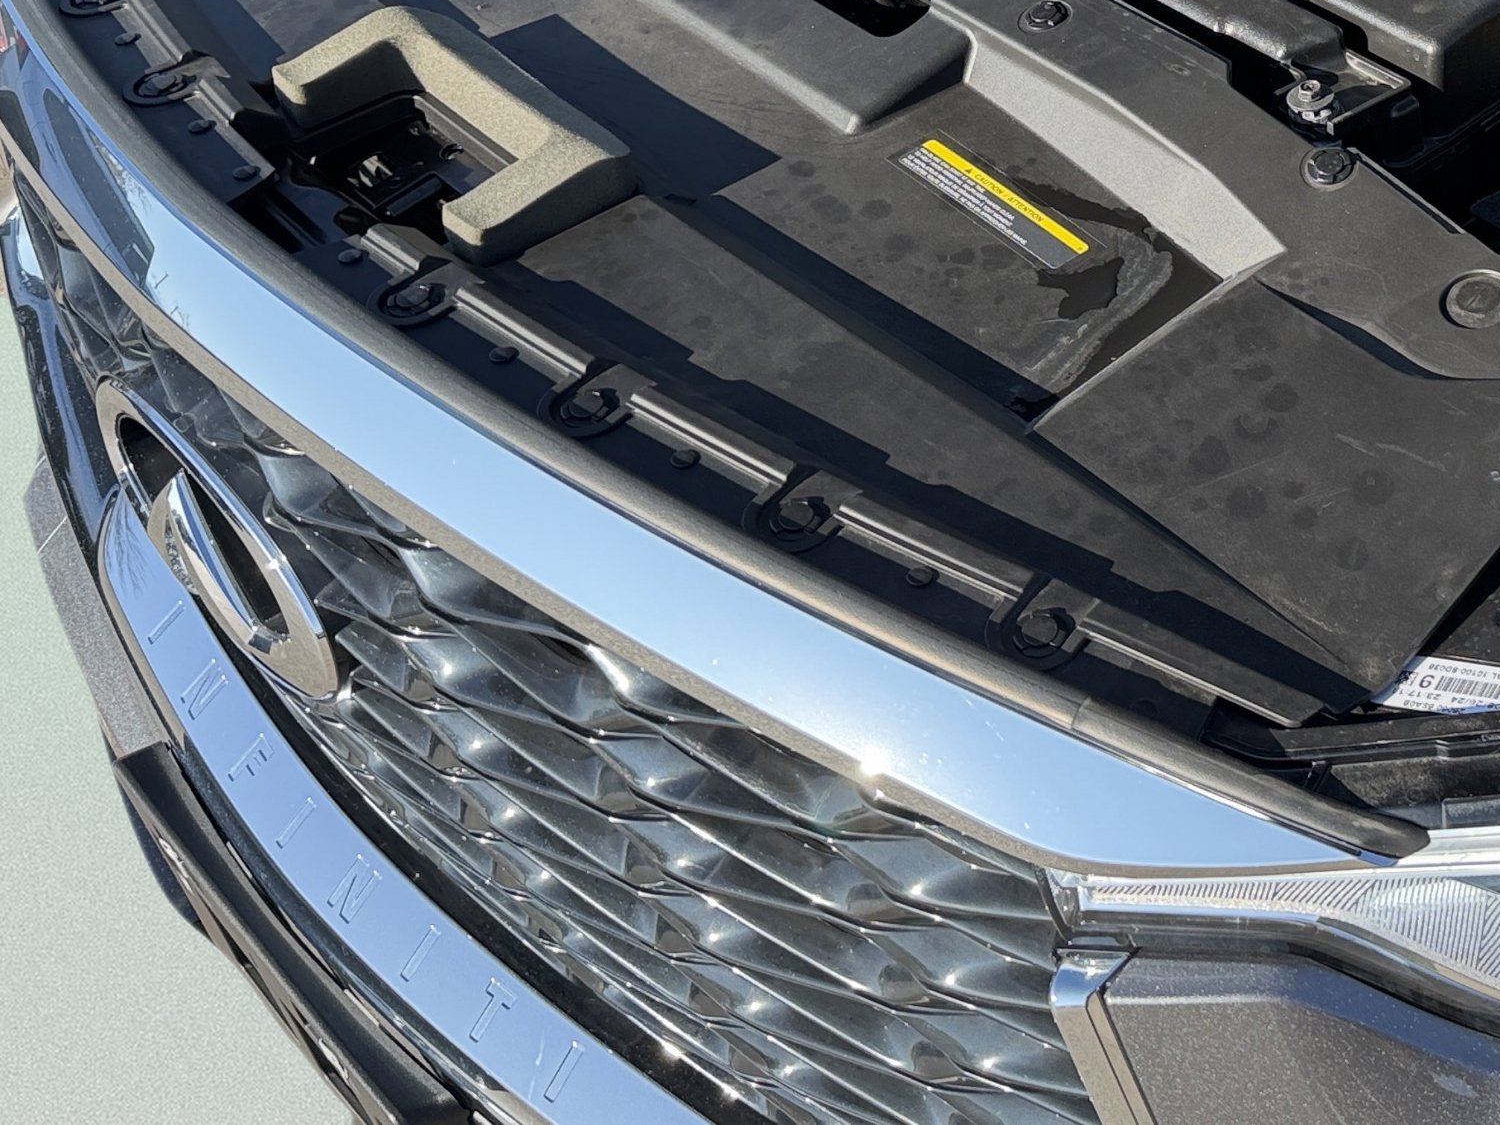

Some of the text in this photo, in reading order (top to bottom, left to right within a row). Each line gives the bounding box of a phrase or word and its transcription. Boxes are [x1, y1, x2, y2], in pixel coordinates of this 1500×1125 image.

[974, 174, 1004, 195] CAUTION
[1007, 196, 1044, 222] ATTENTION
[148, 600, 586, 1103] INFINITI
